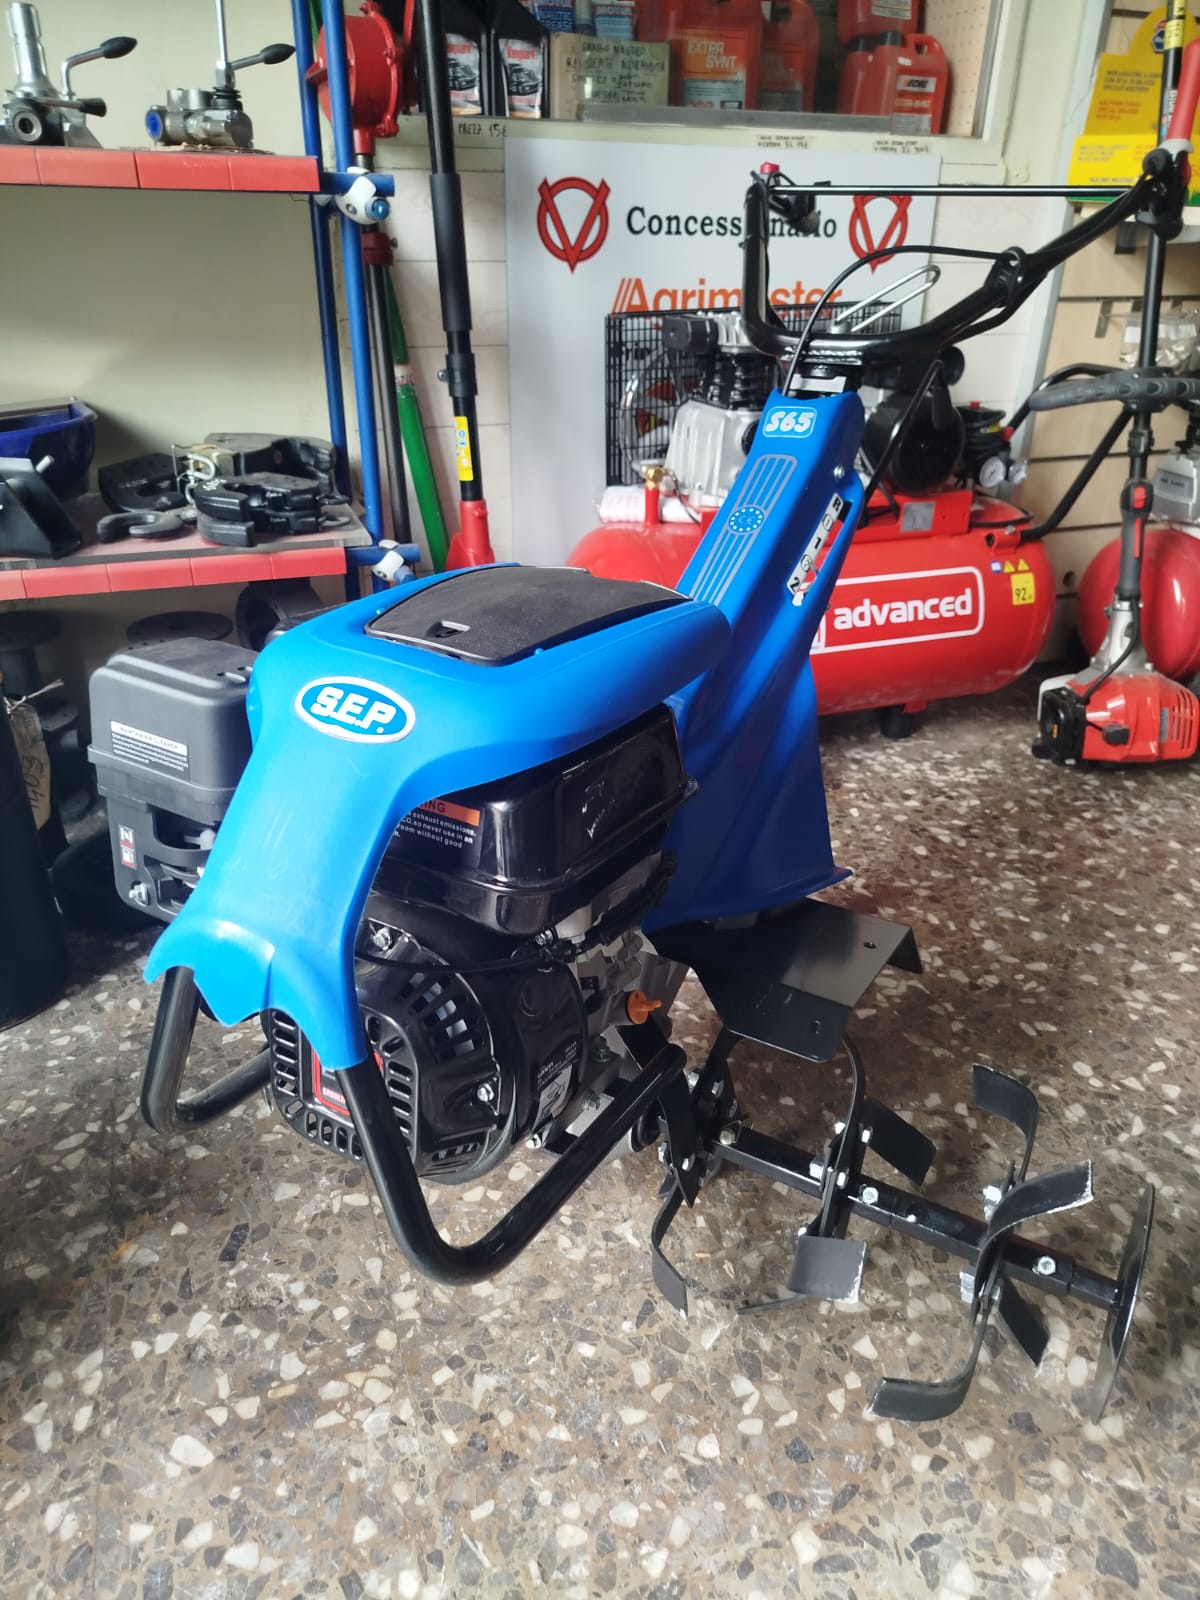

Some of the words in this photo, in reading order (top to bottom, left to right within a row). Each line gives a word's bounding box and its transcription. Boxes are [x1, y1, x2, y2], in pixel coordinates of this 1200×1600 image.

[706, 55, 737, 69] SYNT
[765, 411, 815, 433] S65
[832, 497, 842, 513] R
[814, 536, 822, 550] 1
[790, 576, 800, 593] 2
[1015, 587, 1027, 602] 92
[833, 587, 973, 631] advanced
[413, 812, 440, 825] exhaust
[440, 820, 477, 837] emissions.
[422, 822, 442, 832] never
[416, 829, 443, 843] without
[444, 838, 463, 849] good
